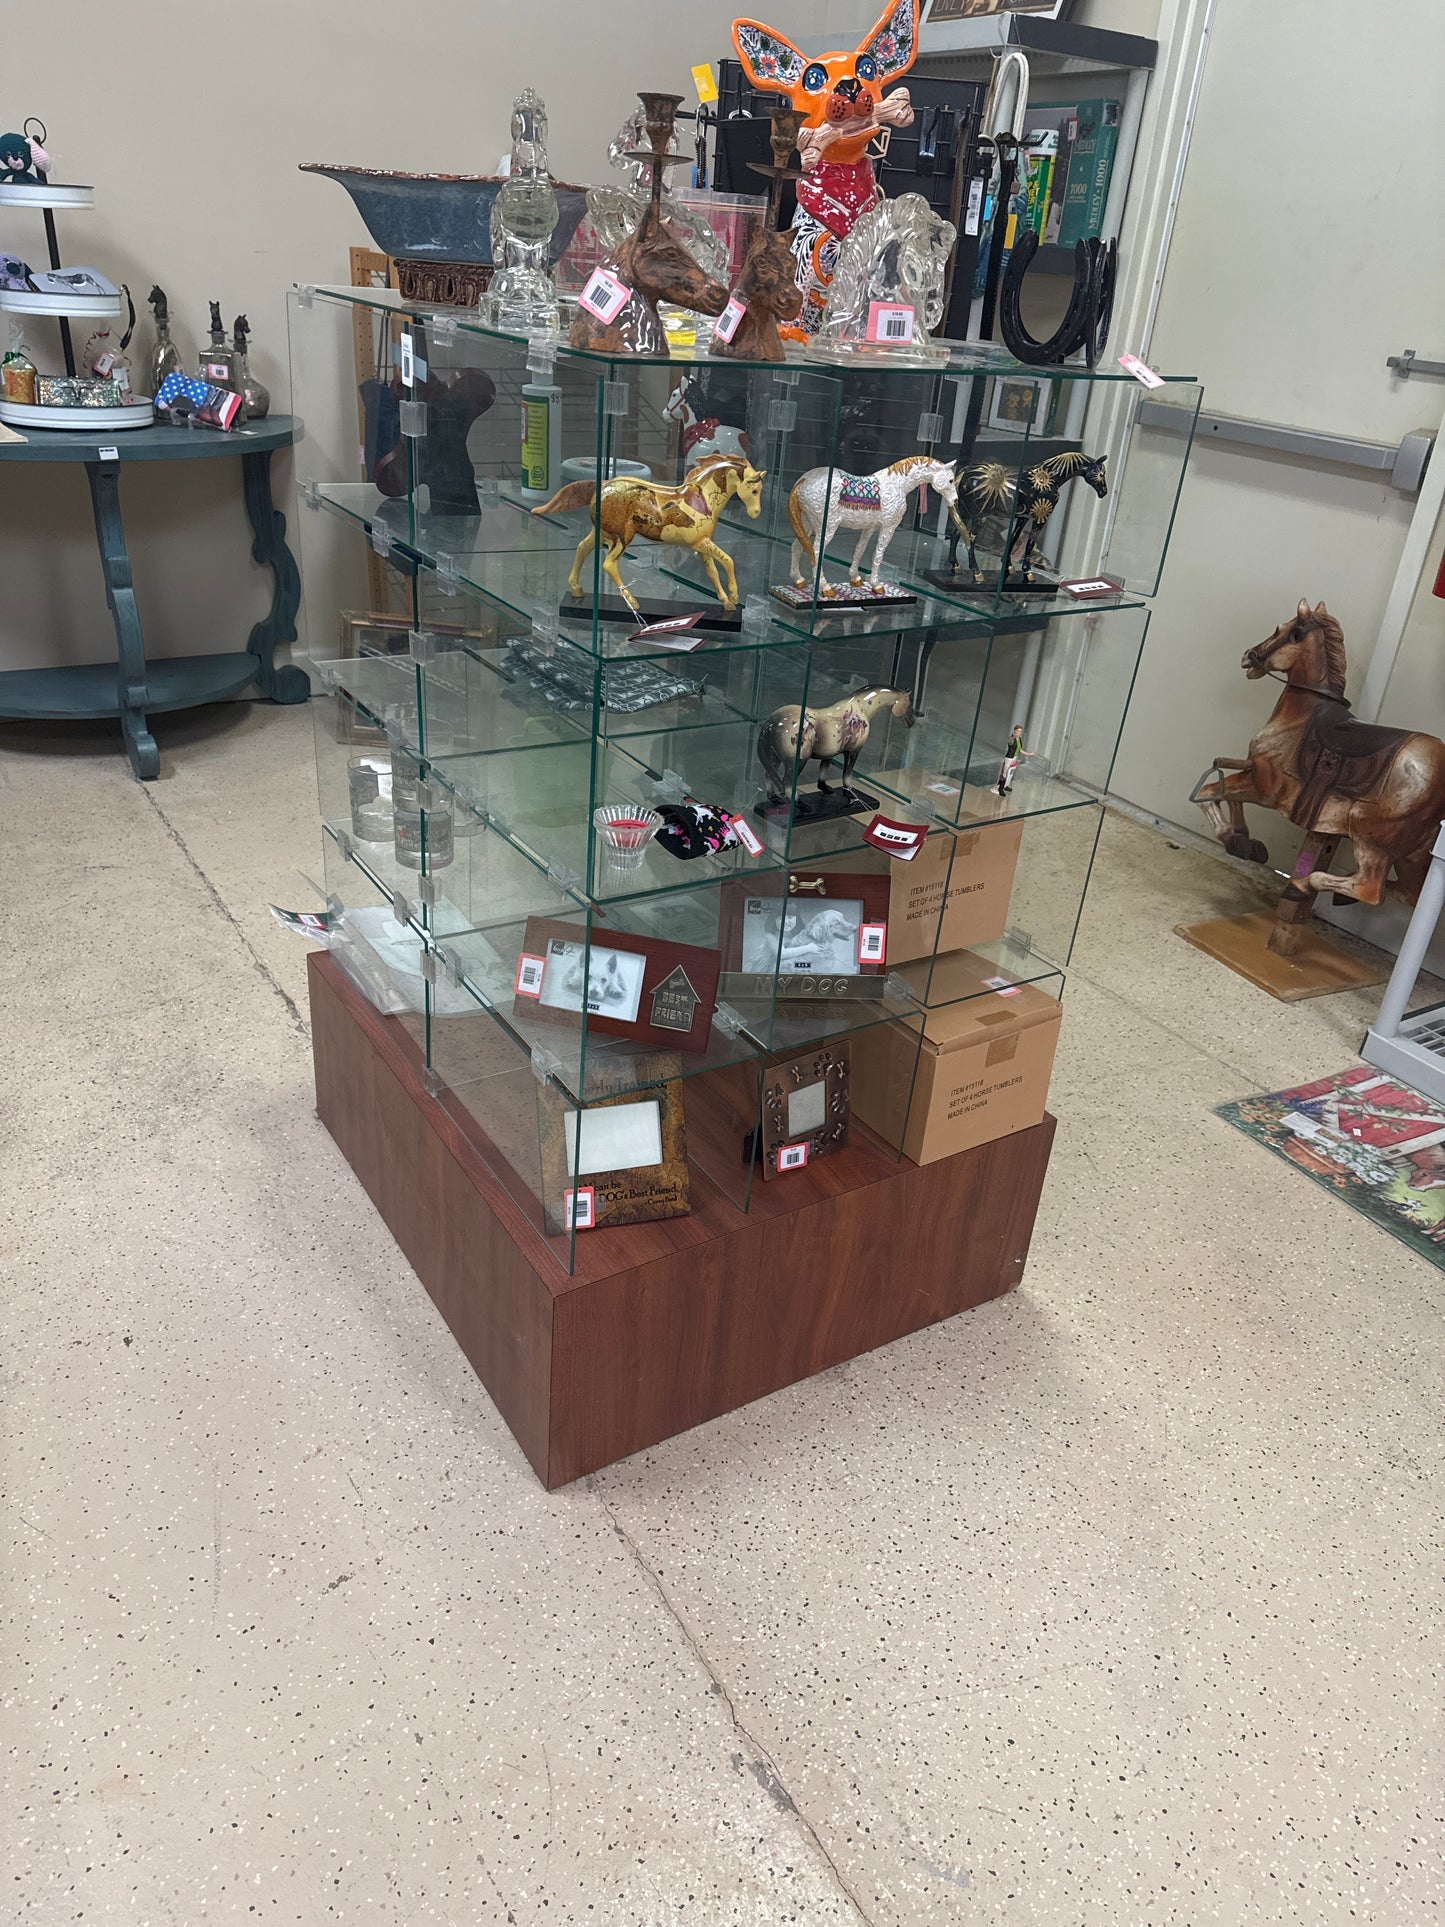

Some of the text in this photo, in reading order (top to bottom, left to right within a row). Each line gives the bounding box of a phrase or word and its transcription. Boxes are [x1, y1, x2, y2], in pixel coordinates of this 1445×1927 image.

[908, 899, 920, 909] SET
[920, 896, 929, 905] OF
[955, 882, 985, 896] TUMBLERS
[910, 885, 925, 897] ITEM
[906, 903, 949, 921] MADE IN CHIA
[754, 976, 849, 995] MY DOG
[662, 991, 689, 1005] BEST
[654, 1006, 691, 1023] FRIEND
[949, 1098, 961, 1109] SET
[960, 1095, 970, 1104] OF
[973, 1086, 993, 1100] HORSE
[993, 1075, 1023, 1092] TUMBLERS
[951, 1085, 965, 1097] ITEM
[947, 1098, 988, 1120] MADE IN CHINA
[629, 1187, 648, 1199] Best
